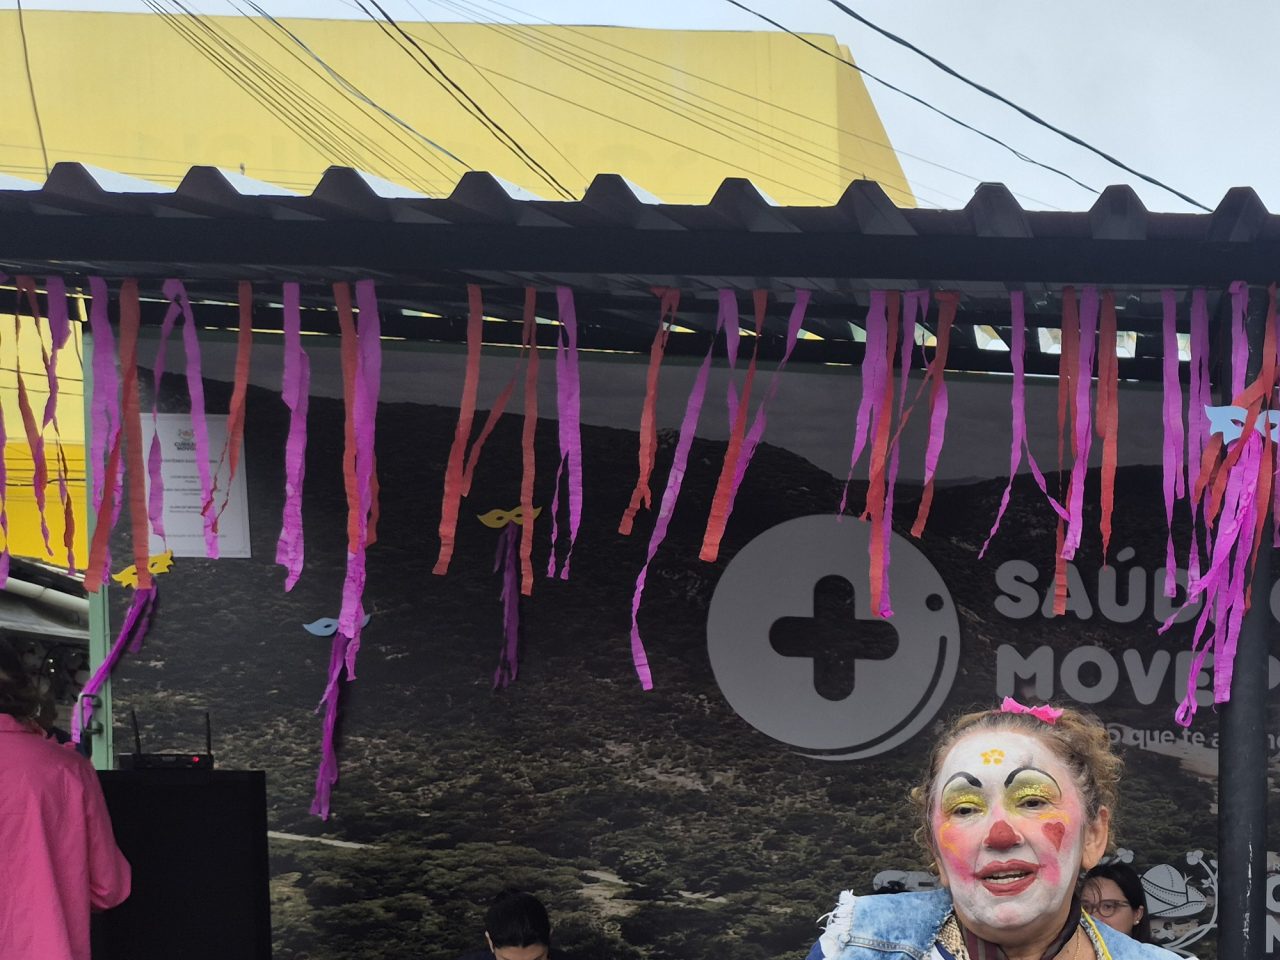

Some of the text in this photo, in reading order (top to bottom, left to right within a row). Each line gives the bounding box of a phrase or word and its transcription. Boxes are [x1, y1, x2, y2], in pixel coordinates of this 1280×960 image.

[994, 546, 1218, 624] SAÚD
[1127, 730, 1175, 749] que
[1180, 728, 1205, 747] te
